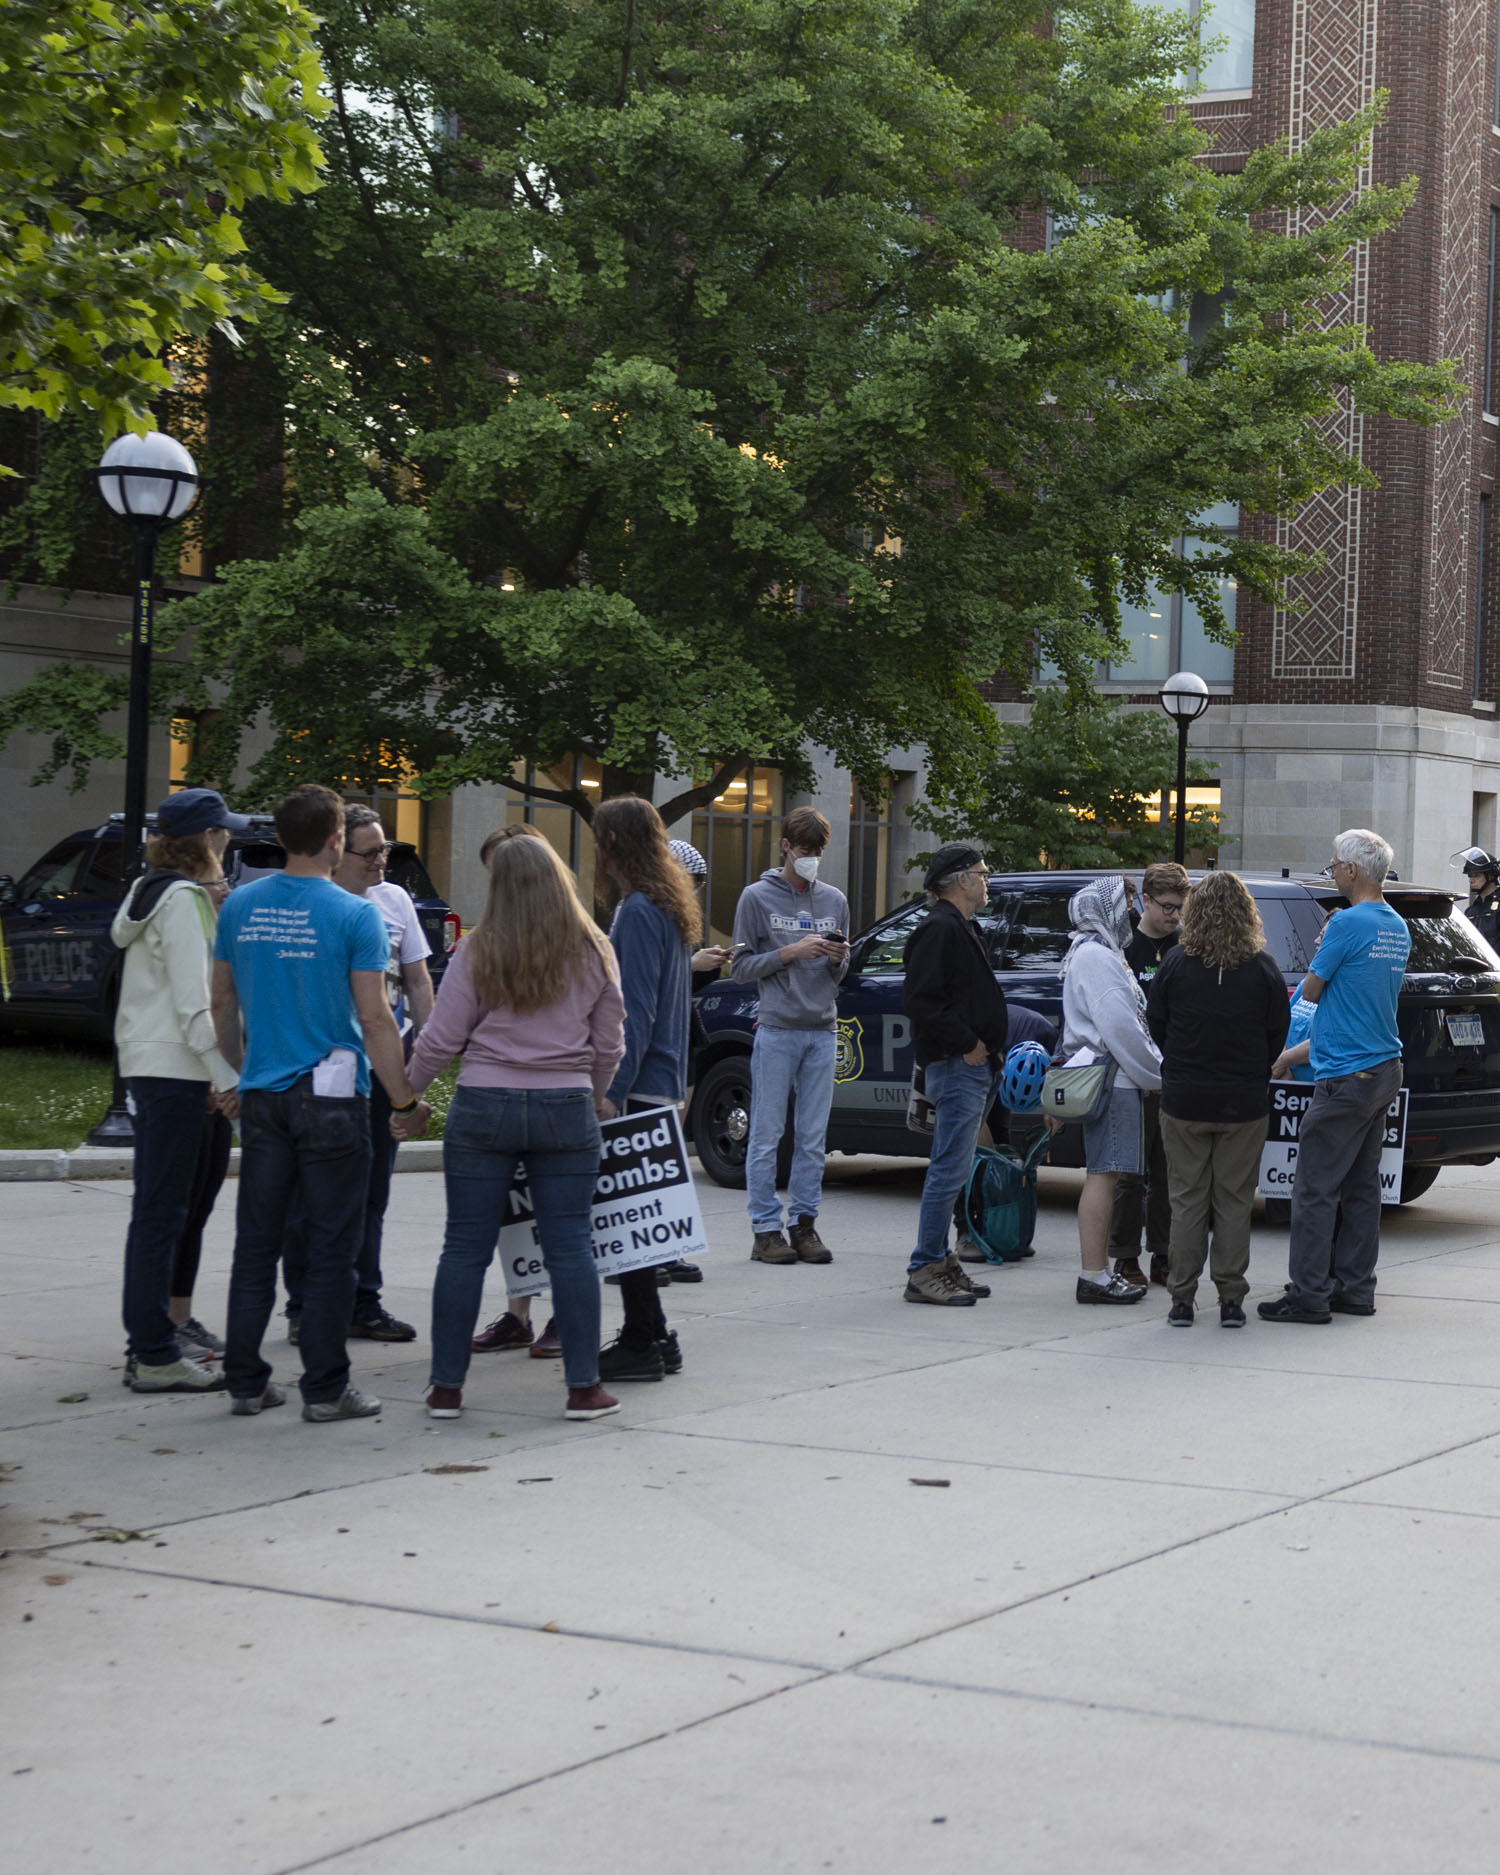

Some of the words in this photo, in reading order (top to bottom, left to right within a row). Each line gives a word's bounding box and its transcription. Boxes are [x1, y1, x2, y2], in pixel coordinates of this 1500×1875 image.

[24, 940, 95, 982] POLICE
[1400, 976, 1421, 993] ICE
[840, 1024, 855, 1038] ICE
[1273, 1089, 1313, 1111] Sen
[600, 1118, 672, 1160] read
[594, 1157, 680, 1194] ombs
[1382, 1194, 1399, 1202] Church
[631, 1216, 693, 1250] NOW
